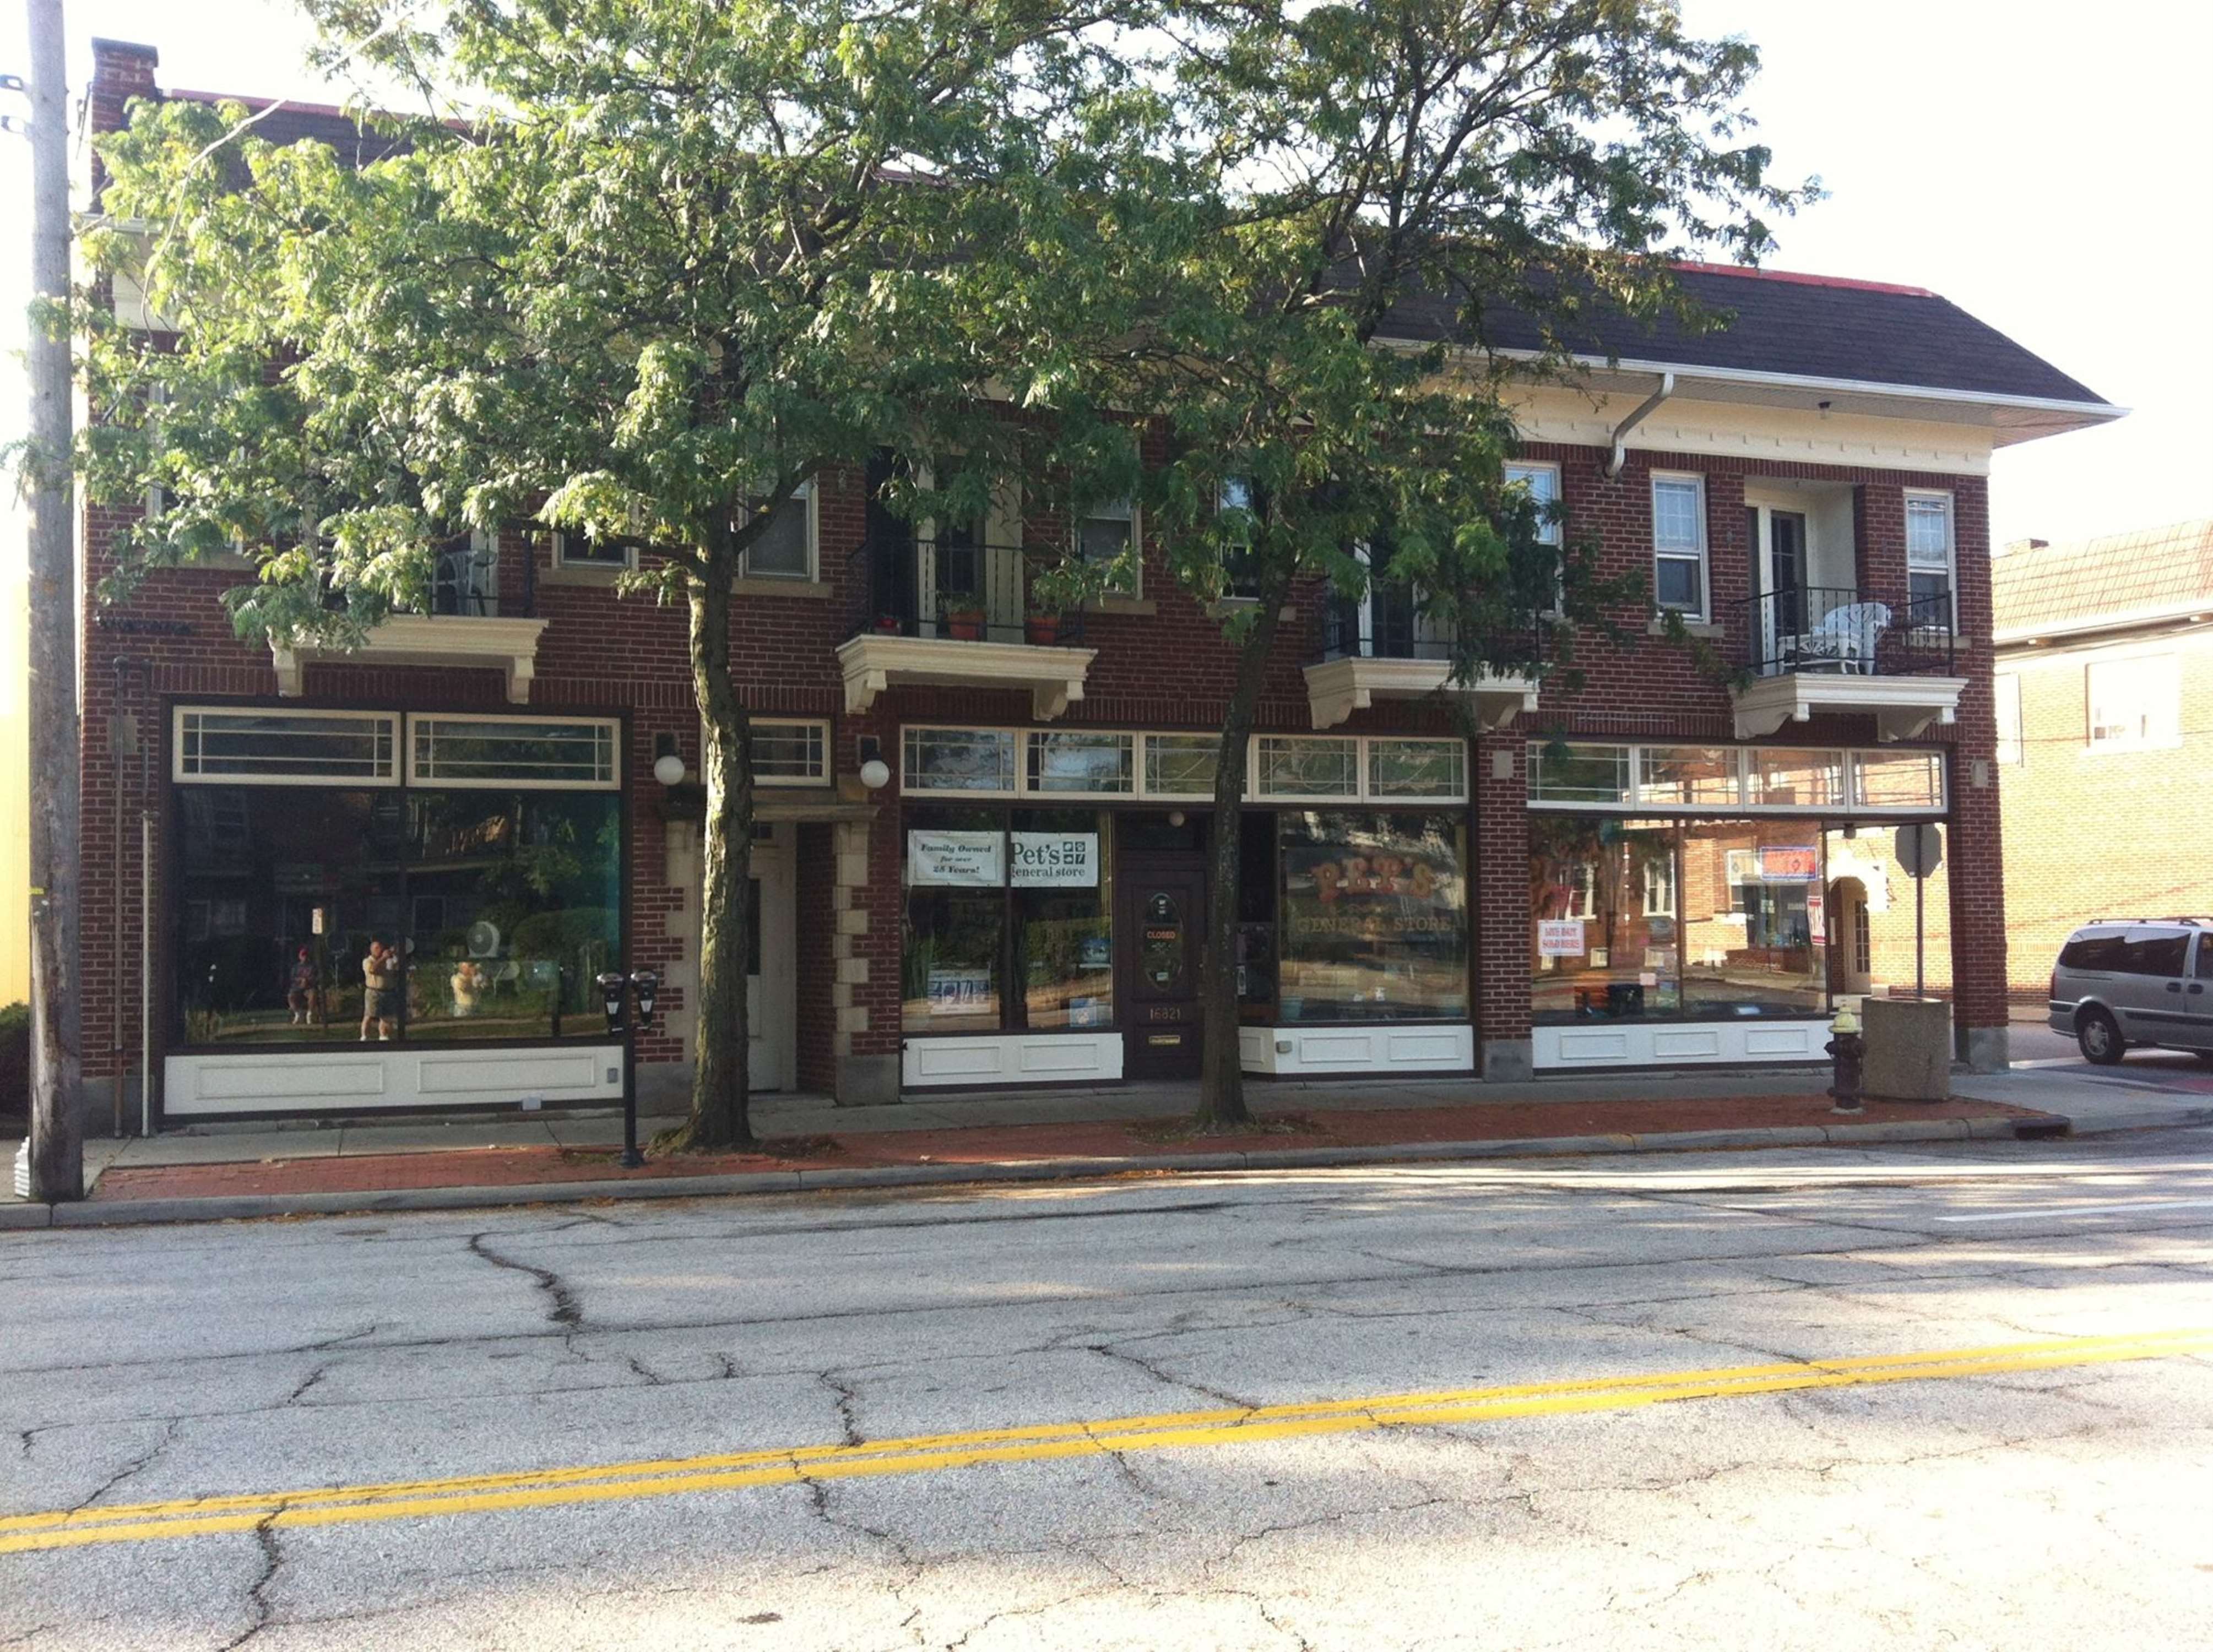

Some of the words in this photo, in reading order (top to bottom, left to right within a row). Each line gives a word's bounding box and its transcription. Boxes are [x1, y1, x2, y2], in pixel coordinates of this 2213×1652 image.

[921, 844, 955, 853] Family
[958, 845, 991, 853] Owned
[1011, 842, 1060, 865] Pet's
[1055, 867, 1085, 877] store
[1297, 916, 1385, 932] GENERAL
[1394, 916, 1451, 931] STORE
[1147, 931, 1176, 939] CLOSED
